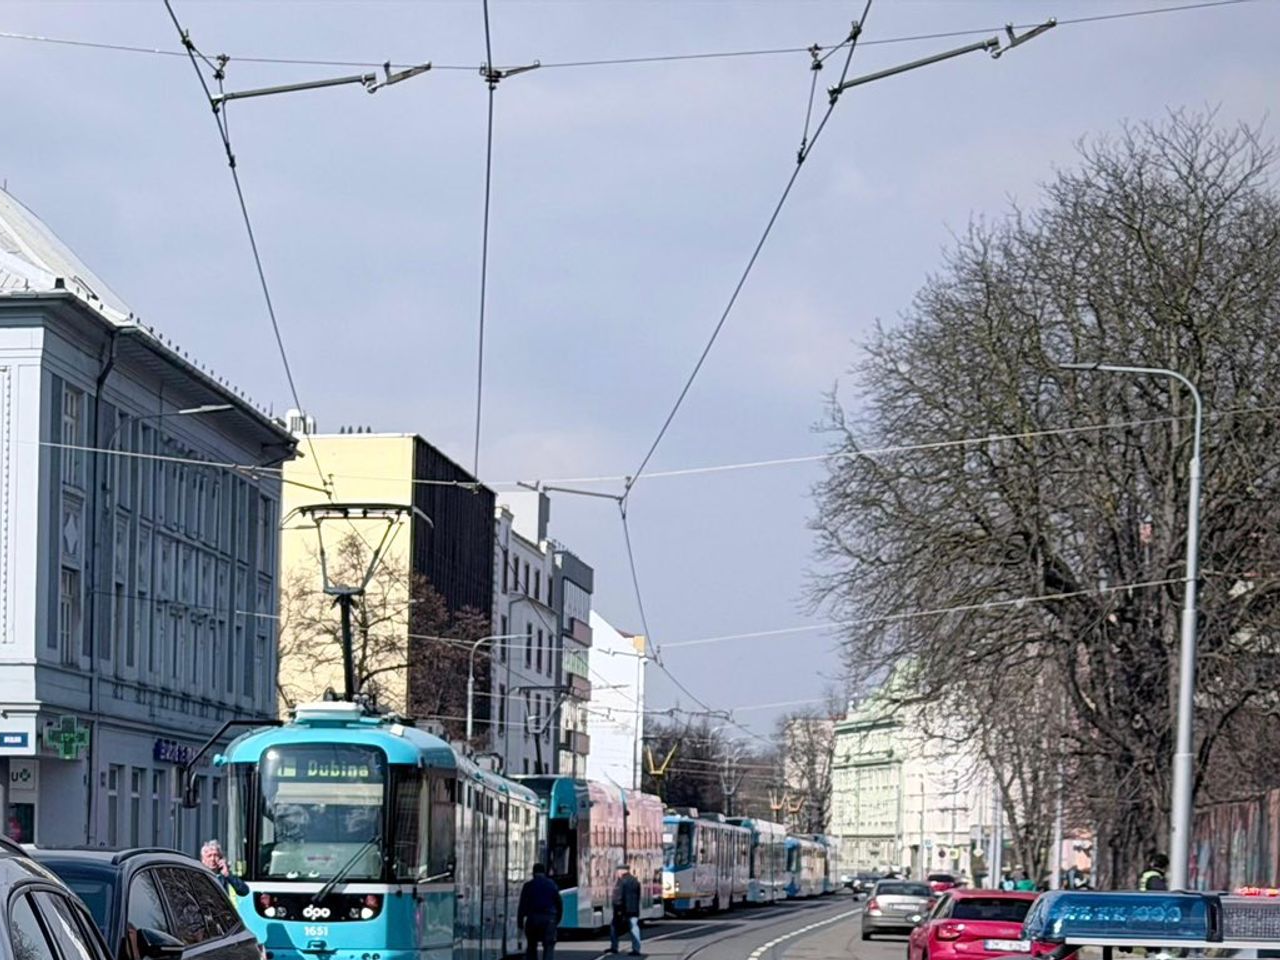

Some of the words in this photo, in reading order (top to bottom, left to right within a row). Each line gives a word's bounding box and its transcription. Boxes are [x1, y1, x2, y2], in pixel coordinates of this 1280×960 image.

[308, 760, 369, 777] Dubina
[302, 904, 331, 920] dpo
[304, 926, 329, 937] 1651
